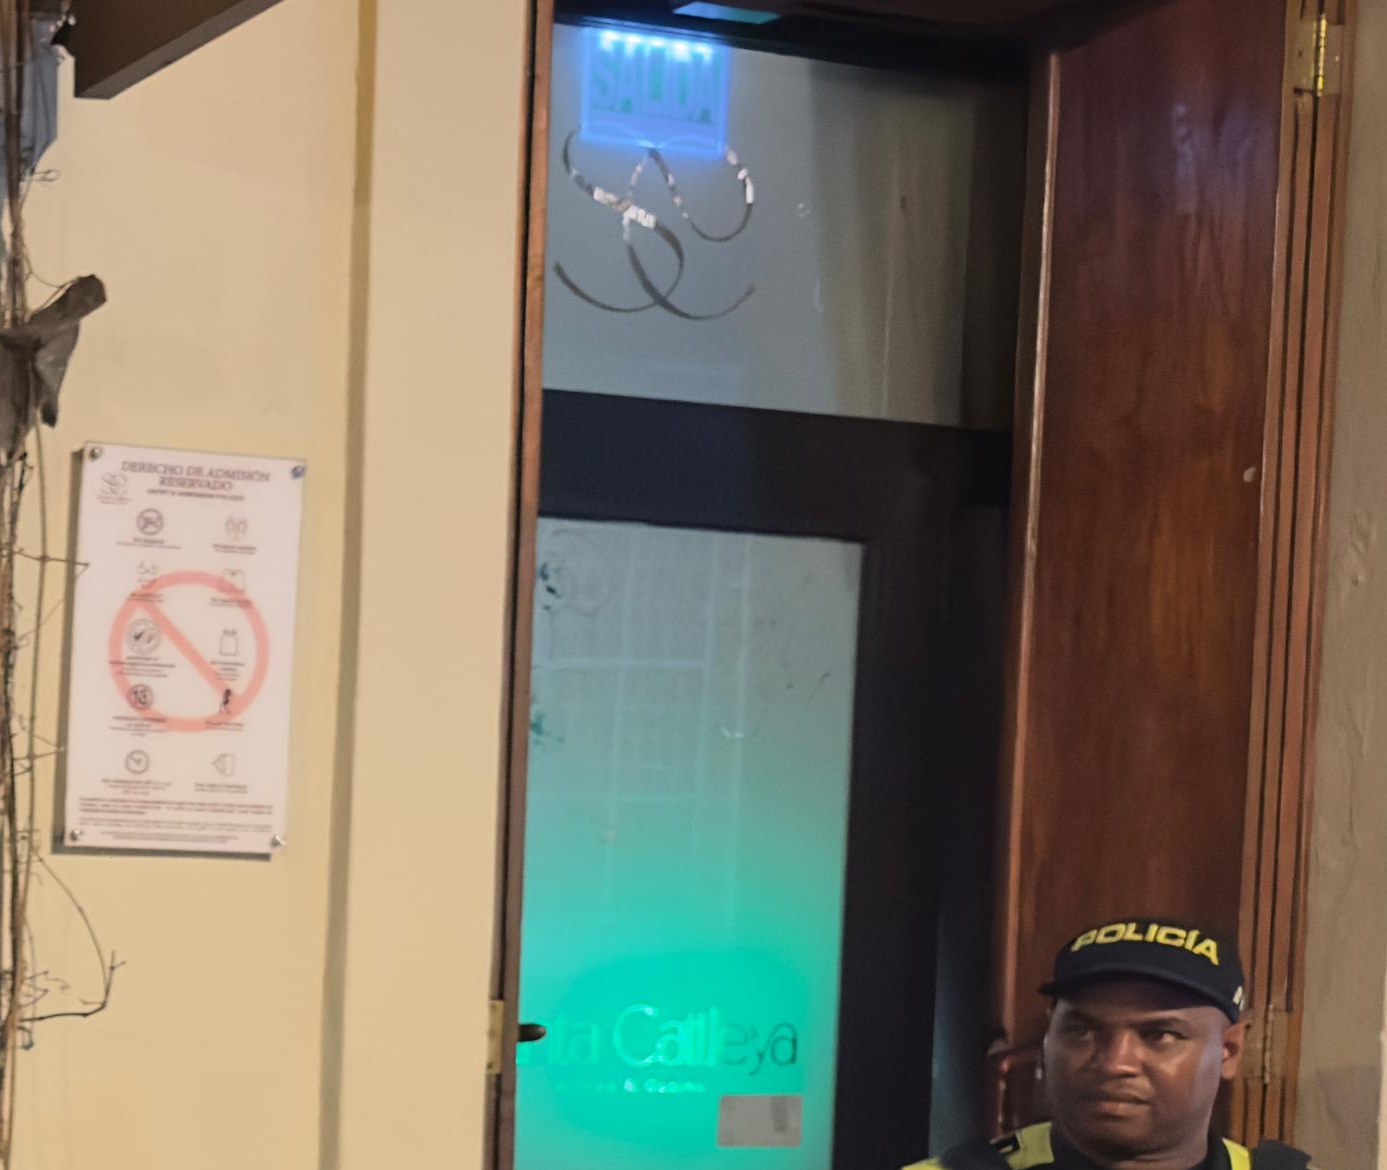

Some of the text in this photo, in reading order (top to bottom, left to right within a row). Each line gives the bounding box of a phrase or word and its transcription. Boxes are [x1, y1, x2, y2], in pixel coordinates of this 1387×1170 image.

[122, 461, 183, 476] DERECHO
[186, 465, 203, 477] DE
[159, 476, 233, 491] RESERVADO
